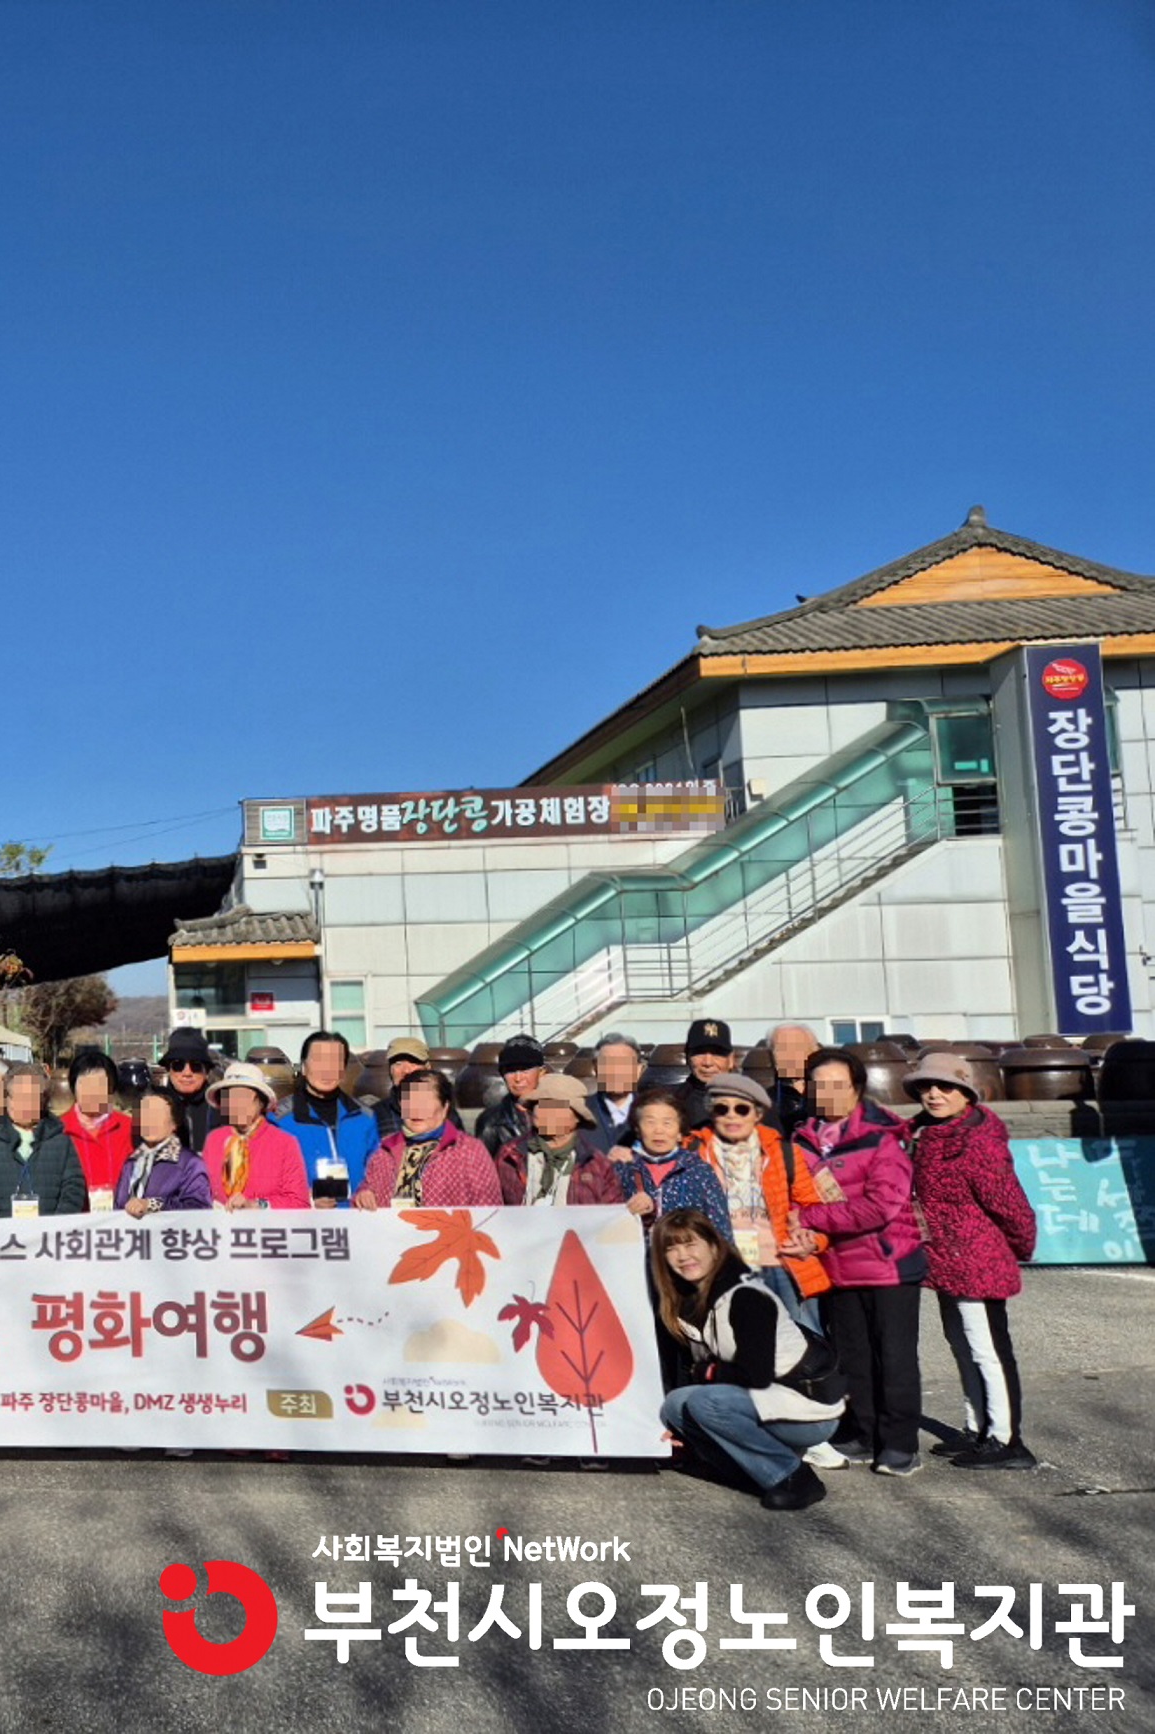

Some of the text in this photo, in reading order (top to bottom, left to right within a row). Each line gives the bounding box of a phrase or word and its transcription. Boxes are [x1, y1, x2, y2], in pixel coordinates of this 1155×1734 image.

[310, 804, 402, 833] 파주명품
[402, 796, 488, 834] 장단콩
[491, 795, 611, 826] 가공체험장
[1048, 708, 1115, 1016] 장단콩마을식당
[35, 1227, 151, 1261] 사회관계
[161, 1227, 220, 1261] 향상
[230, 1227, 350, 1261] 프로그램
[31, 1291, 269, 1364] 평화여행
[0, 1392, 248, 1415] 파주 장단콩마을, DMZ 생생누리
[280, 1394, 317, 1415] 주최
[383, 1390, 605, 1417] 부천시오정노인복지관
